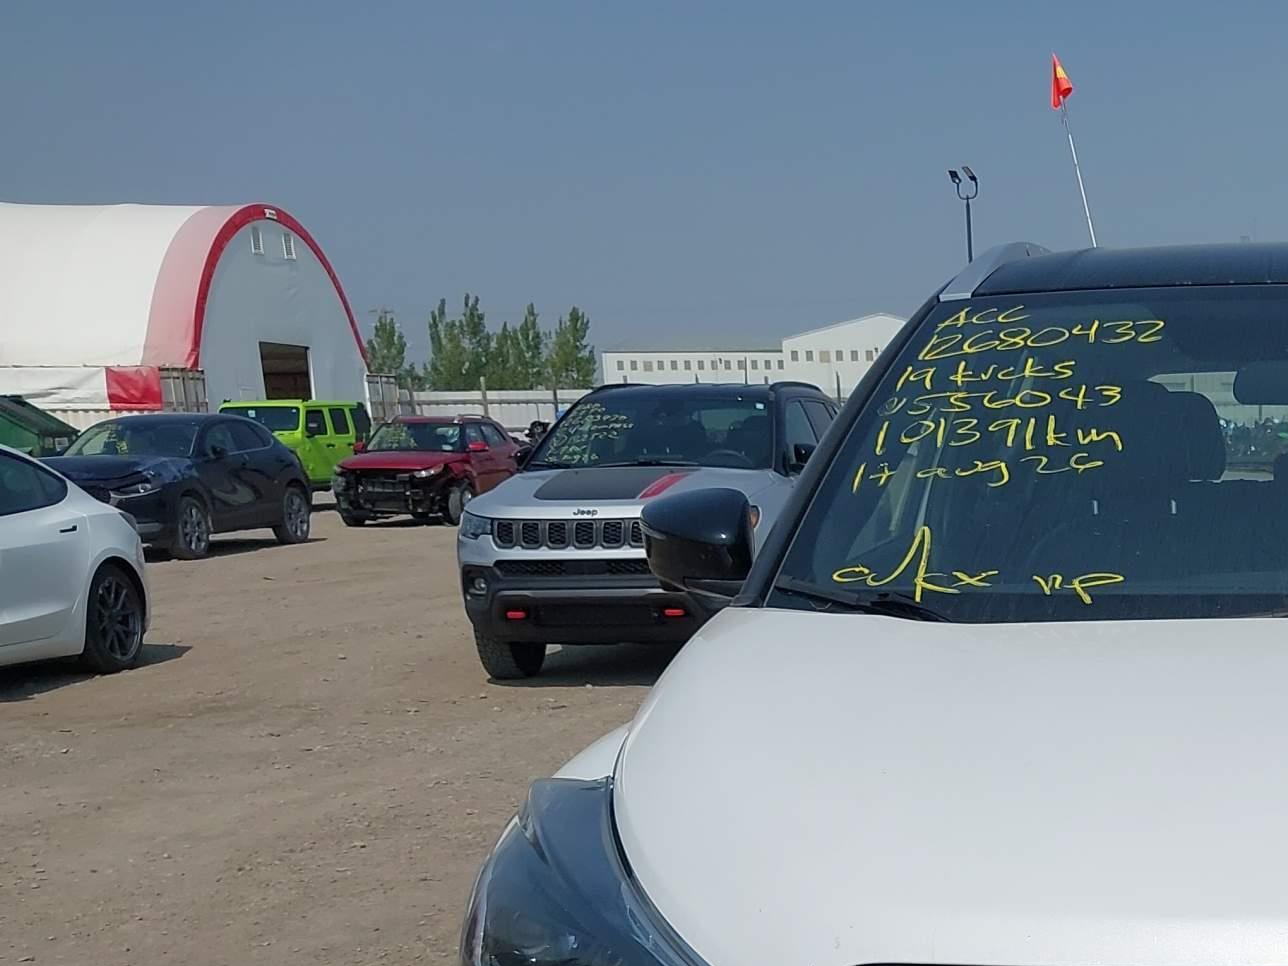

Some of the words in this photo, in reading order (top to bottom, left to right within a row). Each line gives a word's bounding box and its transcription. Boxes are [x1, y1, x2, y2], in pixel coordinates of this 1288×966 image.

[917, 319, 1165, 361] 12680432
[896, 366, 937, 391] 19
[572, 508, 598, 517] Jeep
